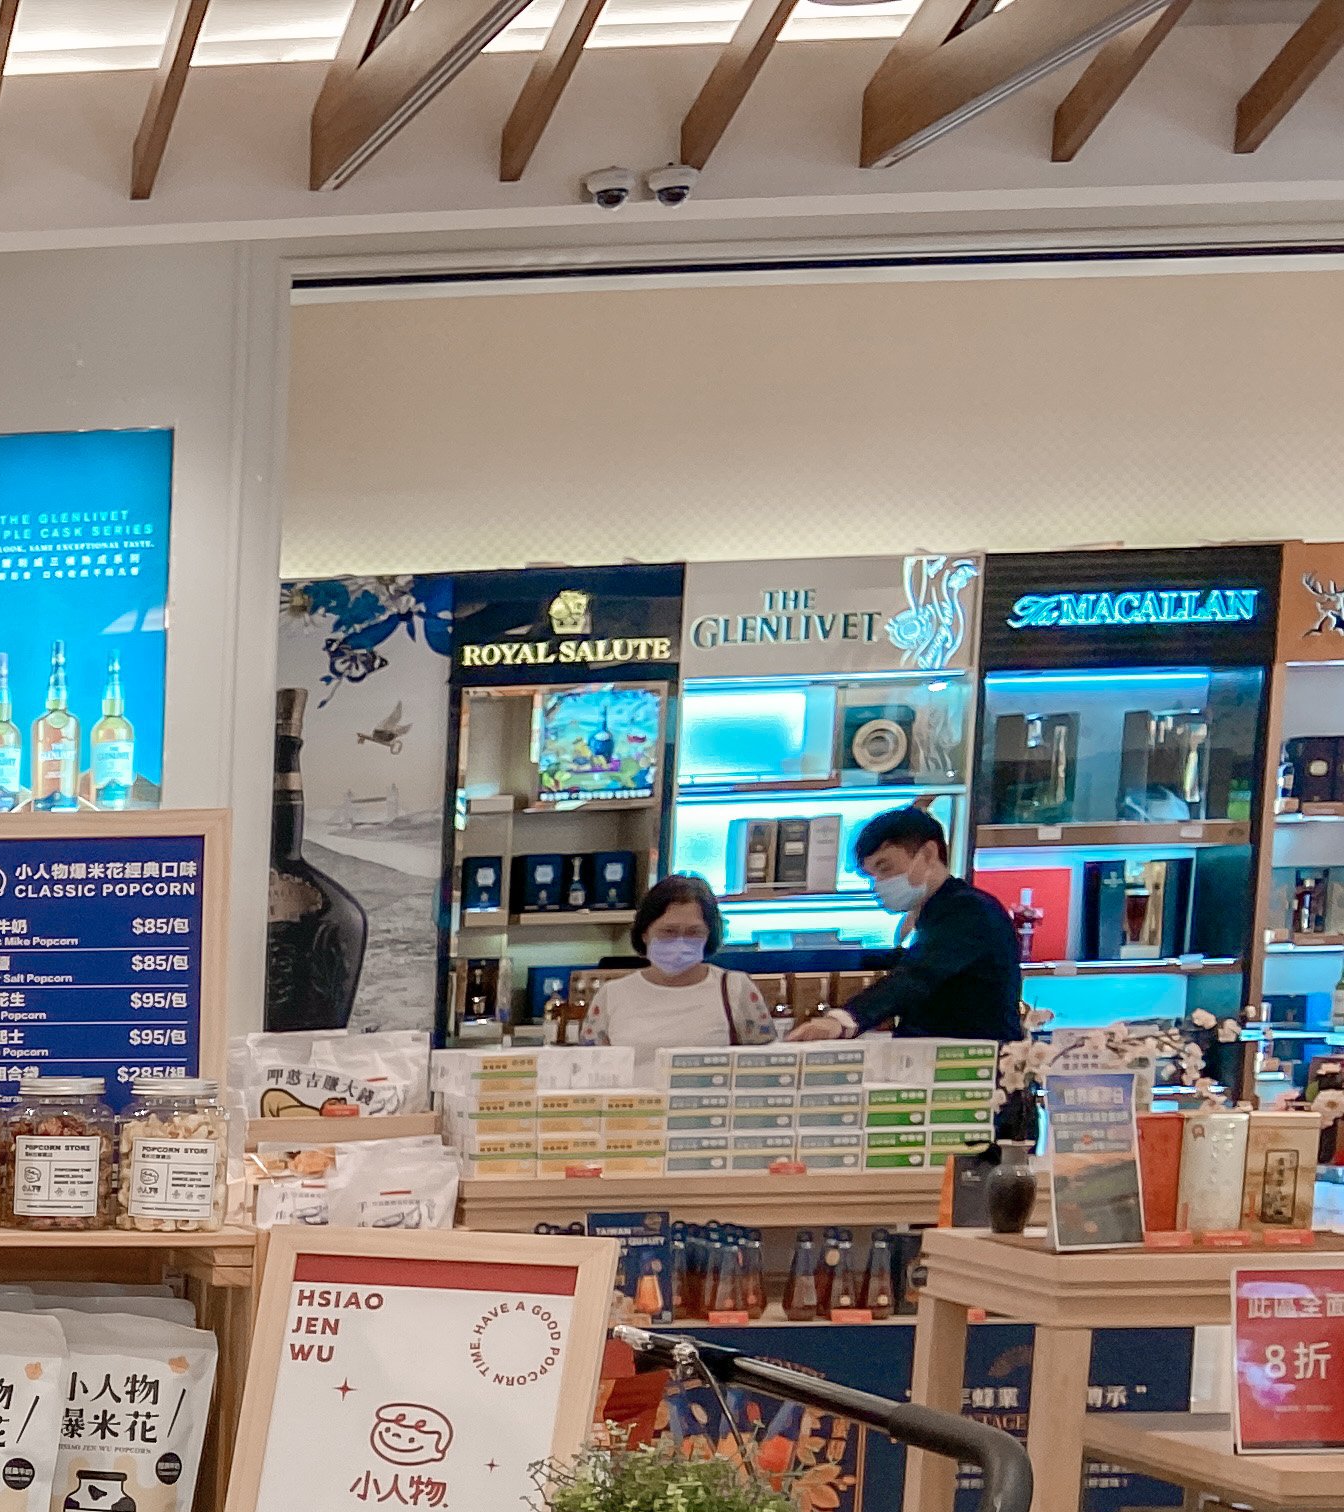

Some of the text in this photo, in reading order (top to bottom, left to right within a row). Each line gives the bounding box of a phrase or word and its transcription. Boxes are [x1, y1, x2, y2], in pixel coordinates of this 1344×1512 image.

[0, 510, 128, 525] THE GLENLIVET
[40, 527, 83, 539] CASK
[91, 524, 154, 537] SERIES
[762, 588, 817, 613] THE
[1060, 589, 1260, 626] MACALLAN
[690, 611, 882, 650] GLENLIVET
[462, 637, 672, 668] ROYAL SALUTE
[15, 861, 198, 880] 小人物爆米花經典口味
[14, 881, 196, 898] CLASSIC POPCORN
[132, 918, 190, 935] $85/包
[32, 936, 79, 948] Popcorn
[131, 955, 189, 972] $85/包
[3, 973, 25, 984] Salt
[26, 973, 73, 985] Popcorn
[130, 992, 188, 1009] $95/包
[0, 1010, 47, 1022] Popcorn
[129, 1029, 187, 1046] $95/包
[2, 1047, 49, 1059] Popcorn
[297, 1288, 385, 1311] HSIAO
[515, 1301, 526, 1311] A
[291, 1316, 340, 1337] JEN
[473, 1302, 510, 1335] HAVE
[531, 1305, 561, 1341] GOOD
[289, 1343, 335, 1364] WU
[1264, 1341, 1332, 1380] 8折
[492, 1346, 561, 1387] POPCORN
[349, 1470, 449, 1506] 小人物
